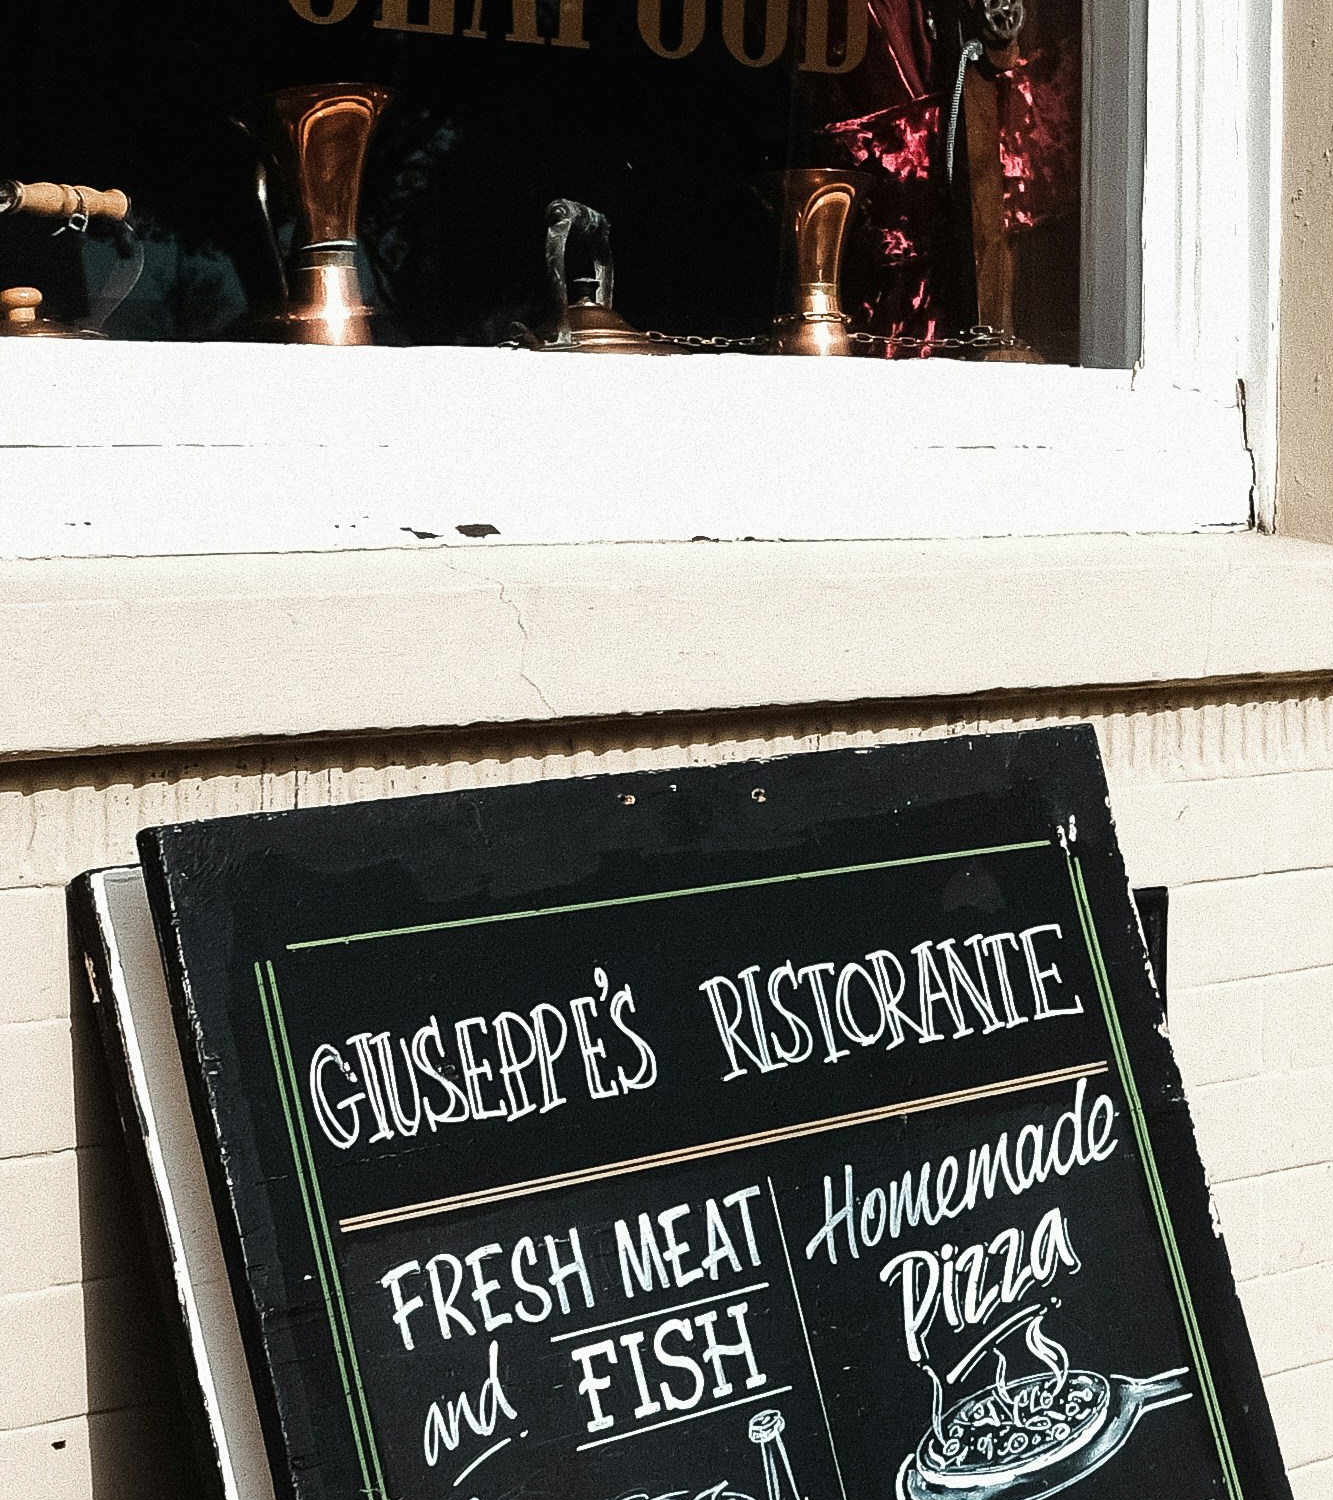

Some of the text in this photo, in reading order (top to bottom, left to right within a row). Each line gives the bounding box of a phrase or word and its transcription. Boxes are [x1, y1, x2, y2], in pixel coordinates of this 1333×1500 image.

[310, 926, 1084, 1149] GIUSEPPE'S RISTORANTE
[810, 1083, 1120, 1262] Homemade
[381, 1185, 761, 1350] FRESH MEAT
[880, 1207, 1081, 1361] Pizza
[424, 1302, 766, 1465] and FISH
